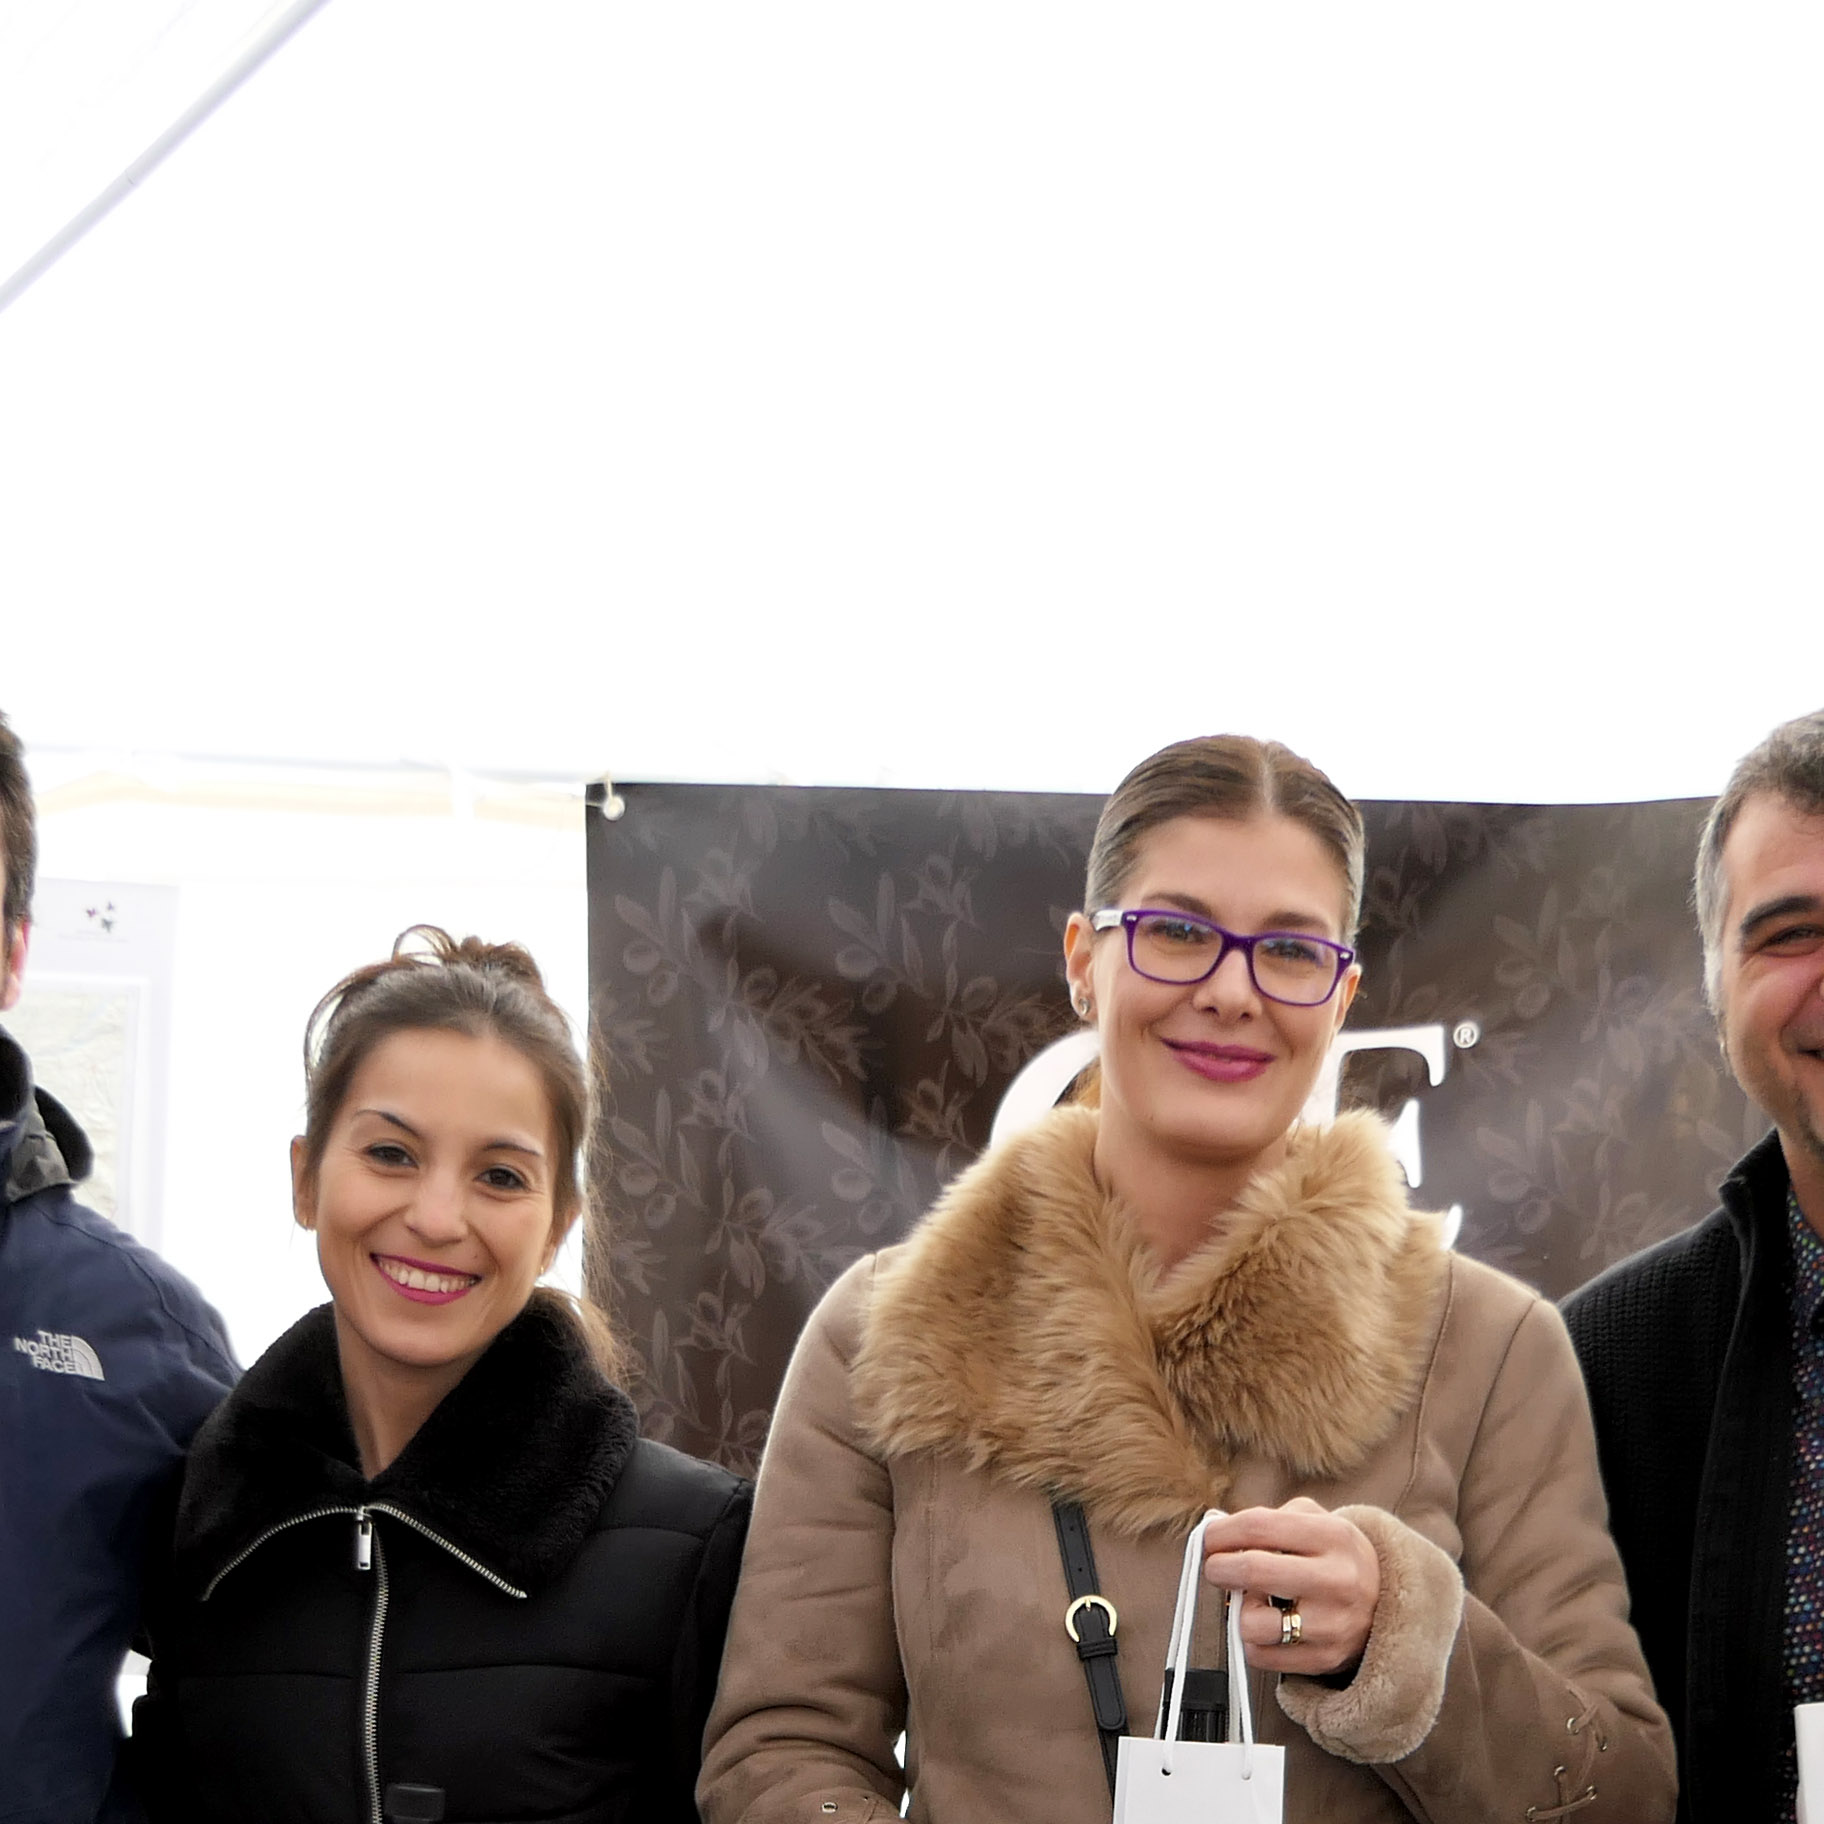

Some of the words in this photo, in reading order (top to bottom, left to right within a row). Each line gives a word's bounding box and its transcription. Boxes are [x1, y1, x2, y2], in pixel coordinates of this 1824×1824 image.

[37, 1330, 73, 1348] THE
[14, 1337, 74, 1361] NORTH
[33, 1356, 76, 1374] FACE
